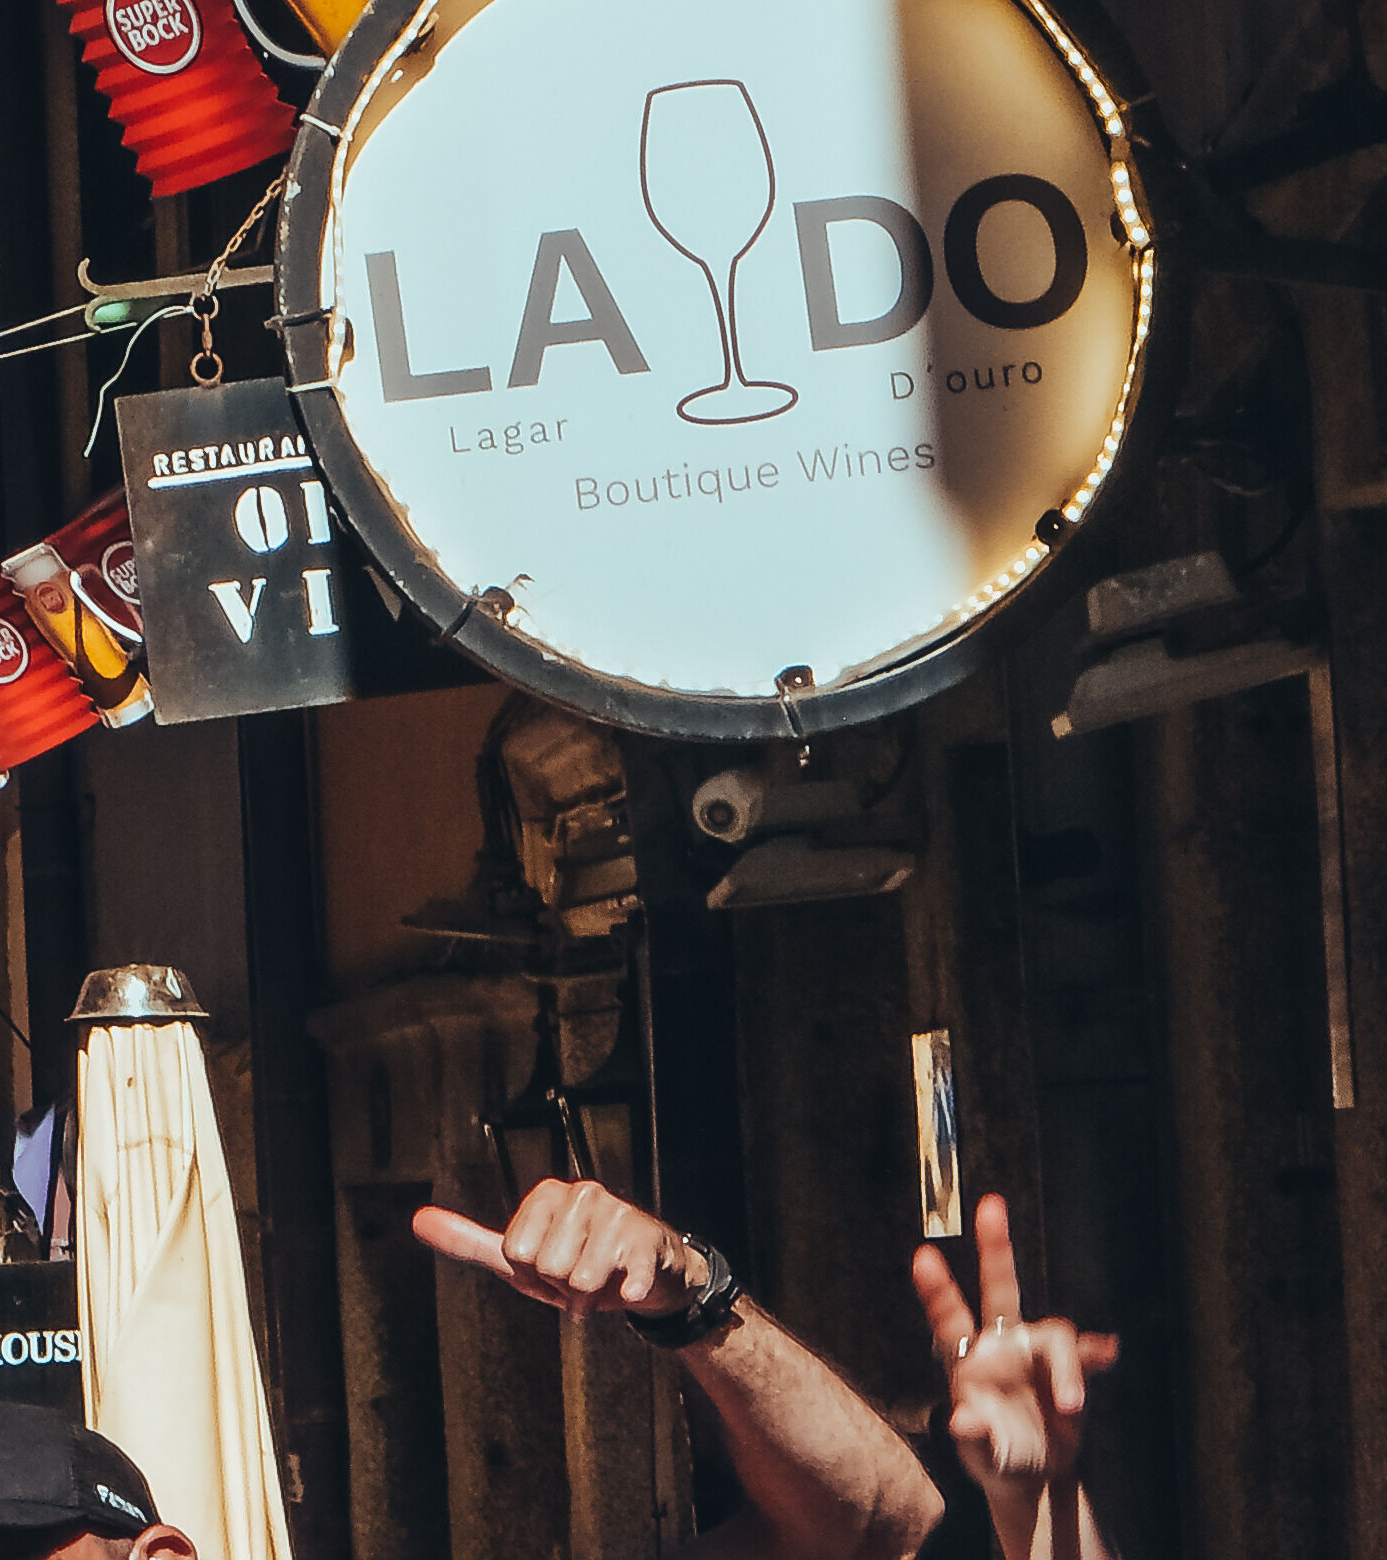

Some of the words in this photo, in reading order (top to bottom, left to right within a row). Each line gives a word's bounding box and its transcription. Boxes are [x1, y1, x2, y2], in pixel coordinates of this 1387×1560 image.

[127, 12, 189, 52] BOCK
[364, 228, 652, 404] LA
[793, 174, 1089, 352] DO
[450, 417, 569, 458] Lagar
[576, 462, 780, 512] Boutique
[797, 440, 936, 483] Wines
